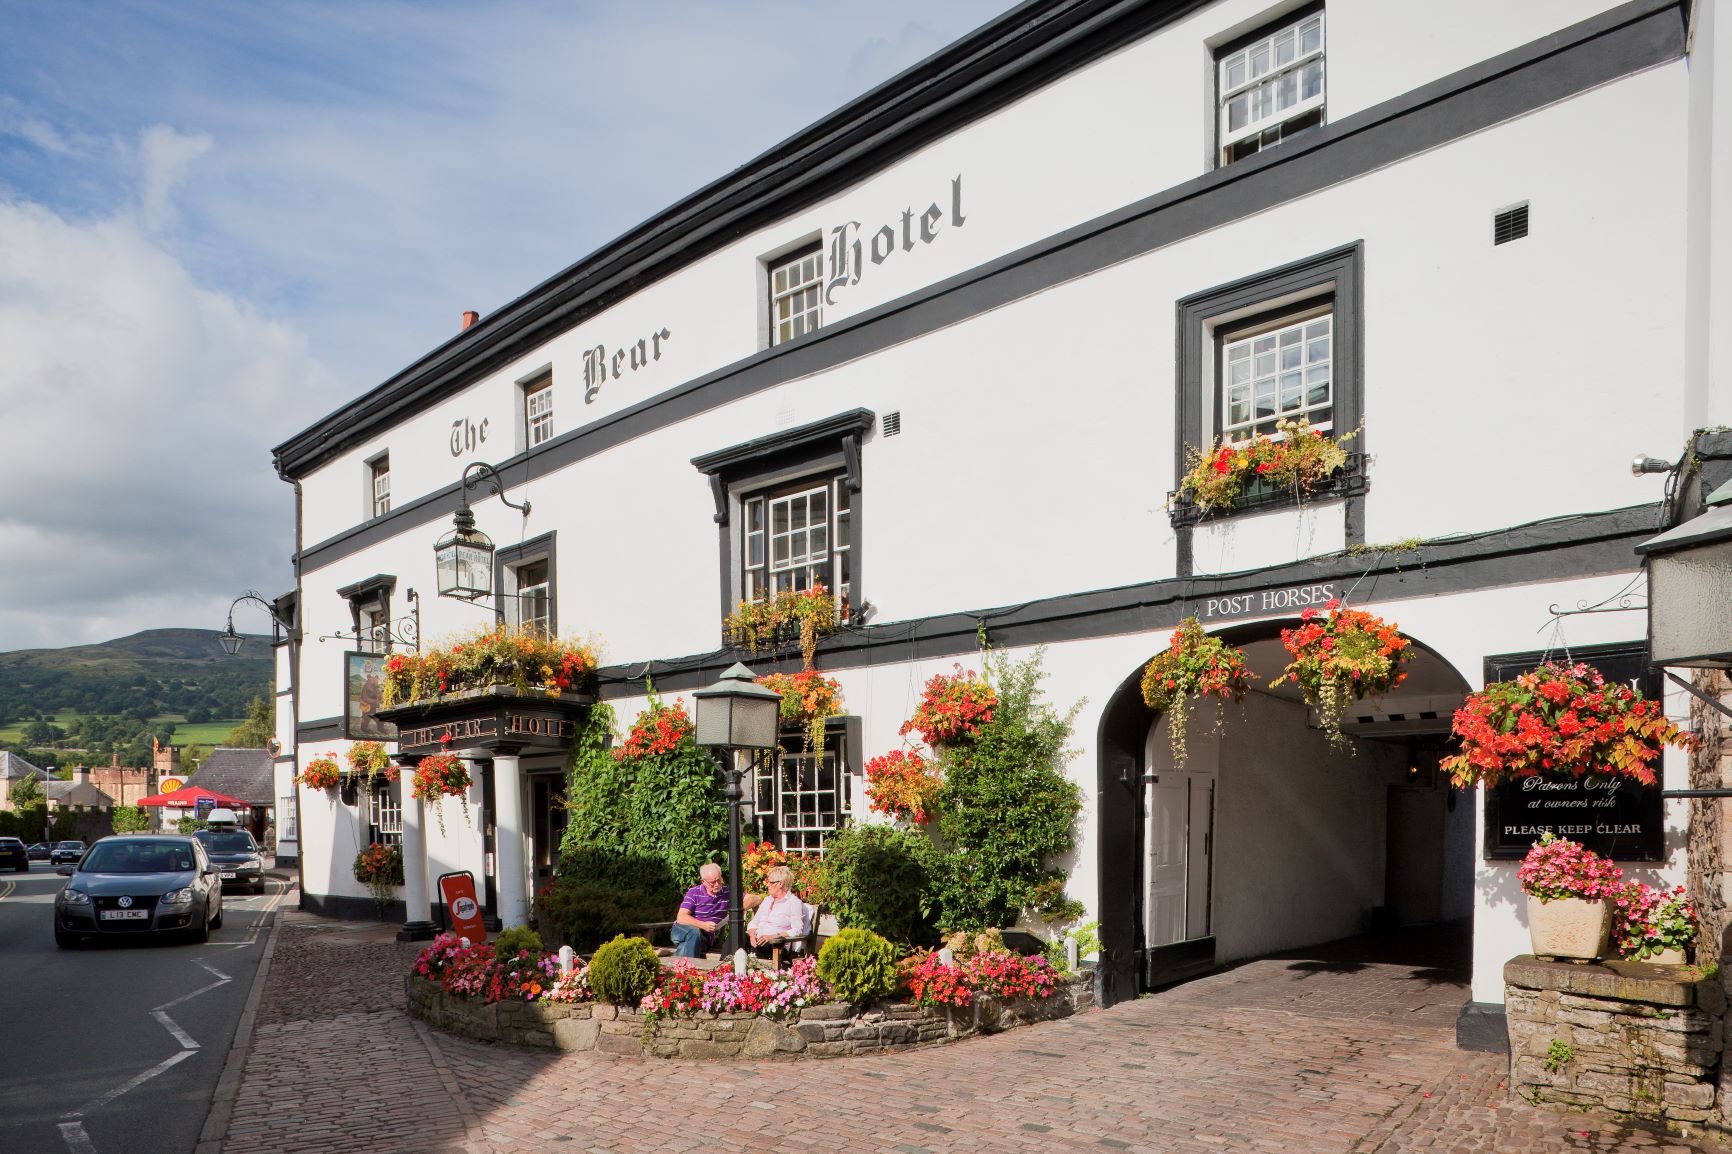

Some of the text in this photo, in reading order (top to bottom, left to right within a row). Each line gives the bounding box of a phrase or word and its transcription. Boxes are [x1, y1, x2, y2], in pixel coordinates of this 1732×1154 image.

[450, 172, 967, 457] The Bear Hotel
[1206, 584, 1334, 617] POST HORSES
[413, 728, 434, 746] THE
[445, 718, 481, 738] BEAR
[1522, 775, 1622, 795] Patrons Only
[1527, 795, 1617, 809] at owners risk
[1504, 824, 1641, 835] PLEASE KEEP CLEAR
